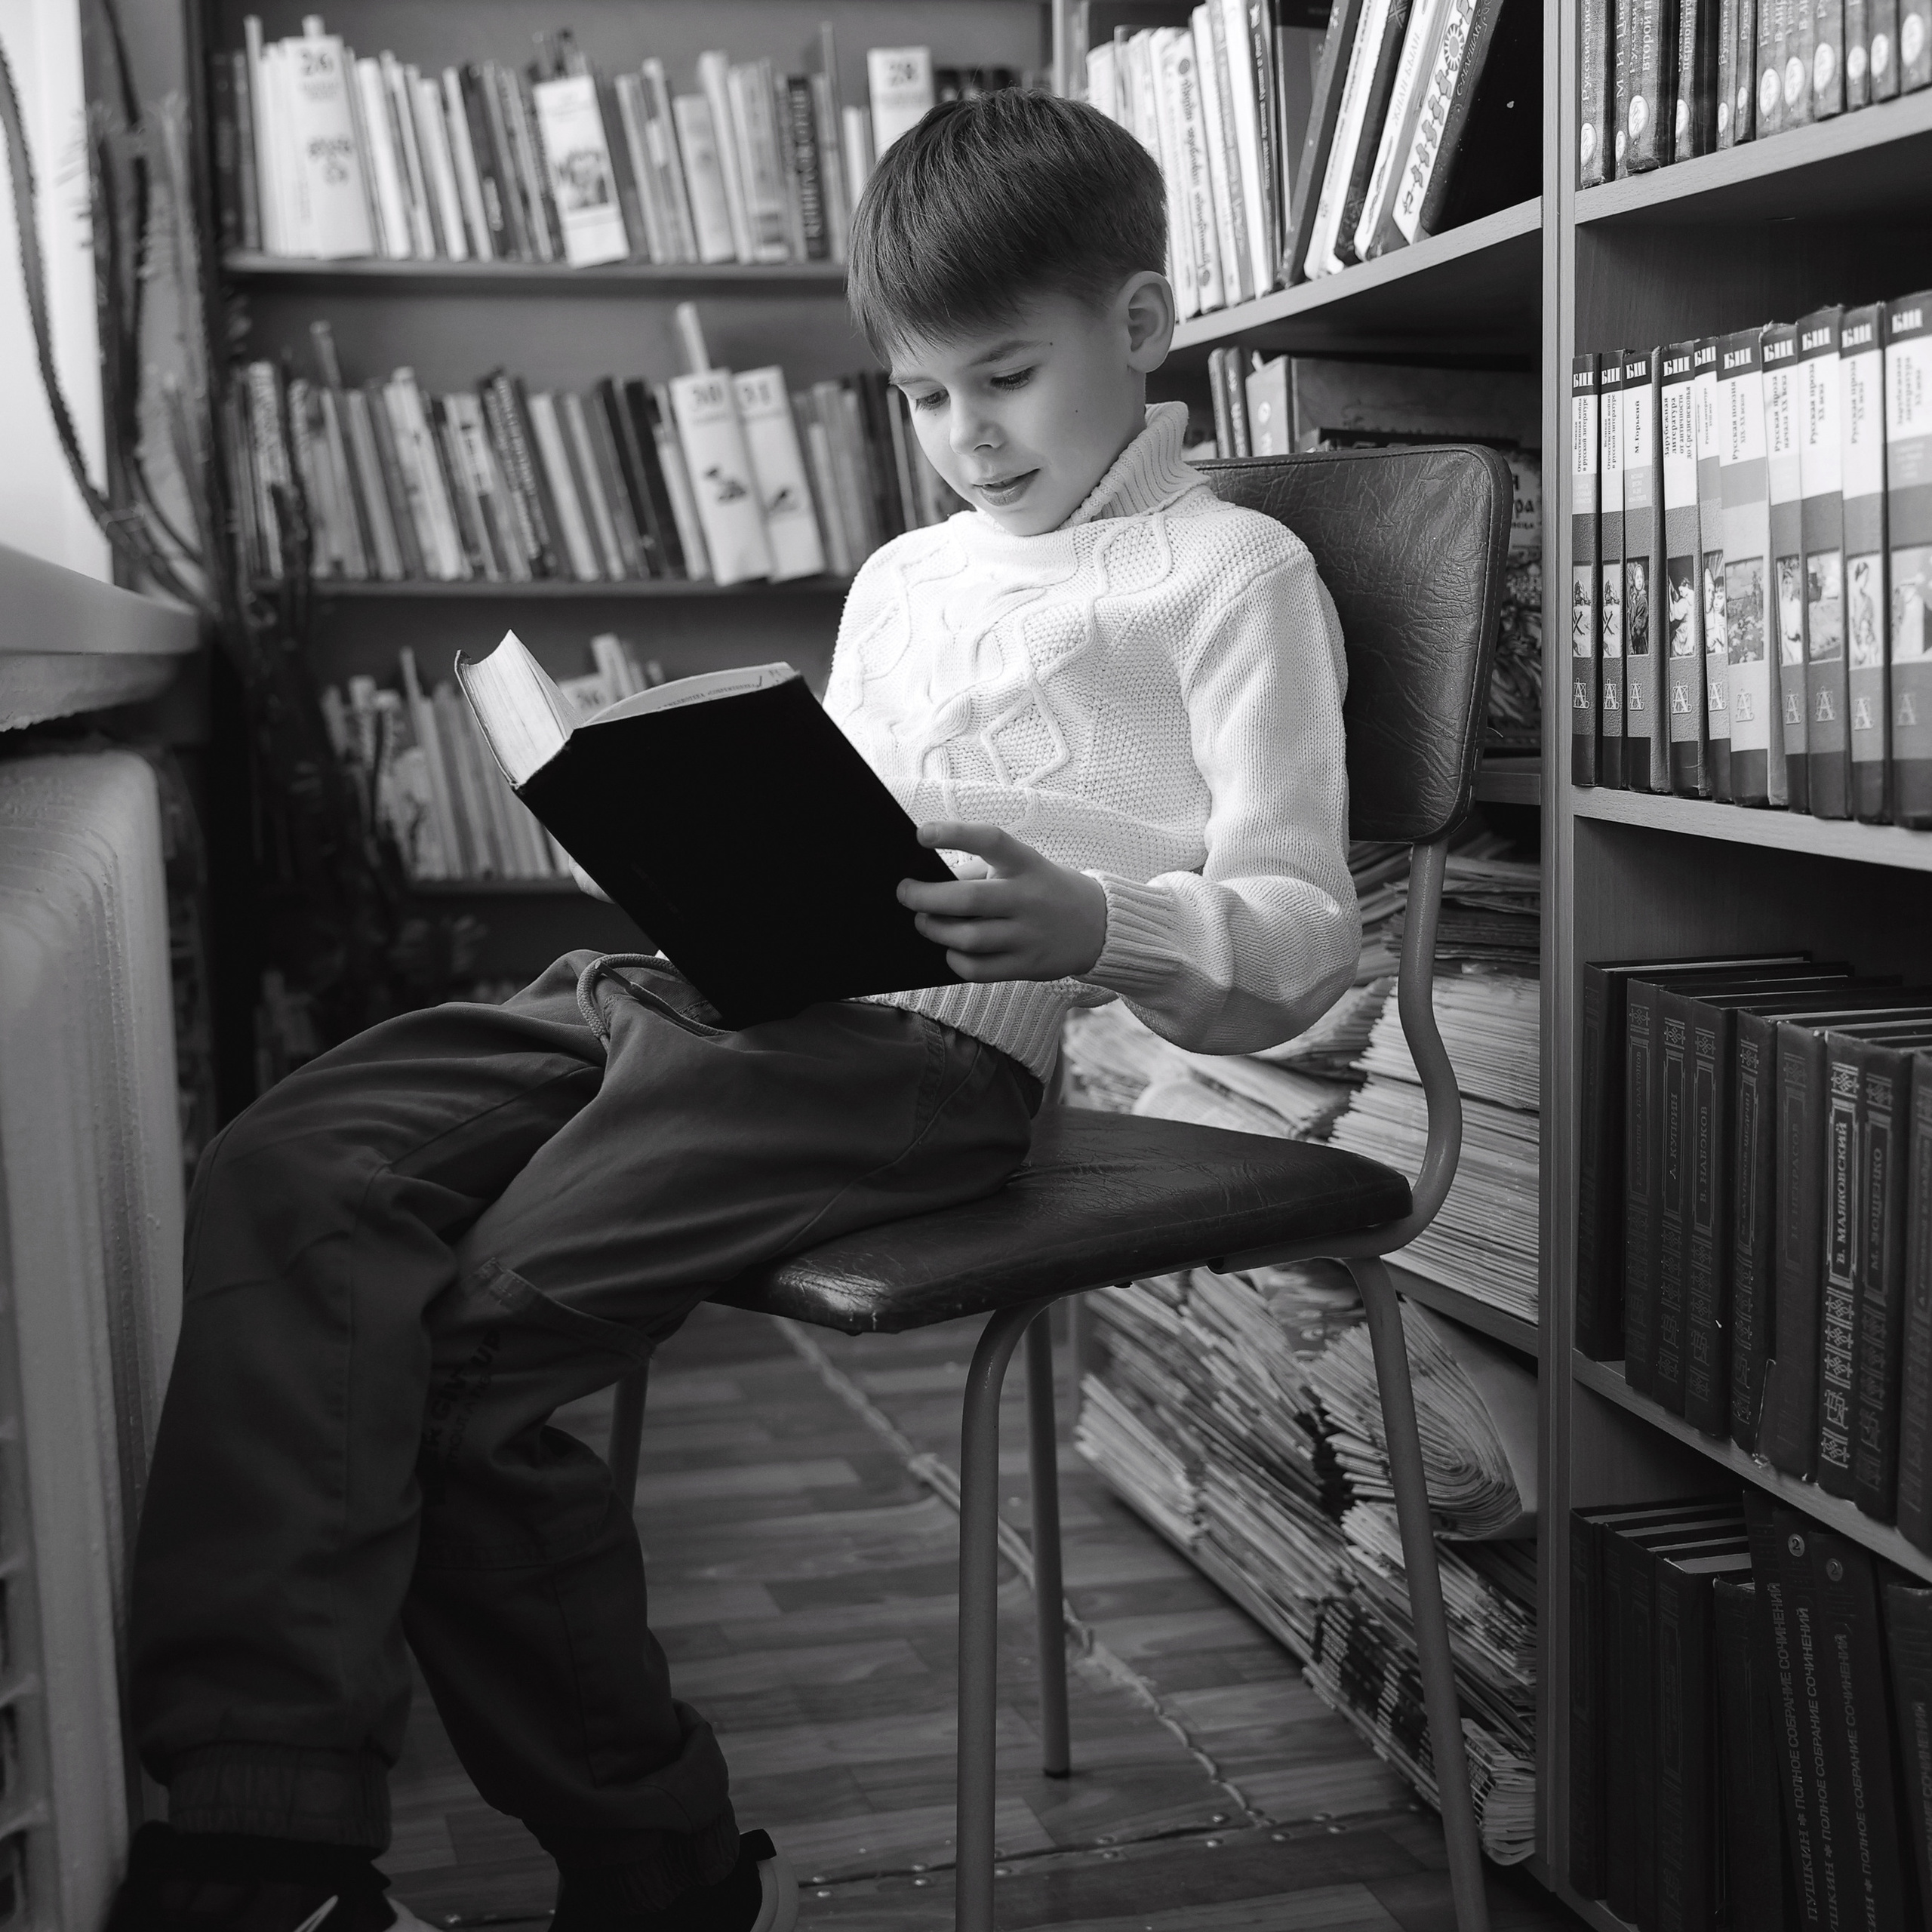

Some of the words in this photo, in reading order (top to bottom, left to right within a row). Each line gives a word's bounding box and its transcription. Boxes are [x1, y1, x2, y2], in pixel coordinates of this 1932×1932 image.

[1640, 15, 1654, 72] второй
[1683, 20, 1693, 71] первой
[1718, 11, 1729, 66] Русская
[1581, 38, 1592, 101] Русские
[1763, 339, 1795, 363] БШ
[1801, 327, 1831, 352] БШ
[1841, 322, 1873, 349] БШ
[1601, 367, 1621, 385] БШ
[1626, 360, 1647, 380] БШ
[1663, 355, 1690, 377] БШ
[1694, 346, 1717, 368] БШ
[1724, 347, 1752, 371] БШ
[1573, 371, 1594, 388] БШ
[1808, 363, 1817, 398] проза
[1809, 400, 1818, 445] Русская
[1850, 399, 1860, 445] Русская
[1635, 443, 1639, 454] М.
[1679, 445, 1684, 454] от
[1687, 449, 1693, 460] до
[1700, 1106, 1708, 1184] НАБОКОВ
[1669, 1164, 1676, 1180] А.
[1835, 1122, 1847, 1244] МАЯКОВСКИЙ
[1700, 1189, 1706, 1203] В.
[1871, 1148, 1883, 1246] ЗОЩЕНКО
[1835, 1249, 1845, 1265] В.
[1870, 1251, 1878, 1270] М.
[1792, 1538, 1801, 1551] 2
[1829, 1562, 1838, 1575] 2
[1767, 1583, 1790, 1669] СОЧИНЕНИЙ
[1796, 1607, 1817, 1697] СОЧИНЕНИЙ
[1834, 1633, 1856, 1727] СОЧИНЕНИЙ
[1780, 1672, 1799, 1748] СОБРАНИЕ
[1808, 1700, 1826, 1777] СОБРАНИЕ
[1789, 1749, 1806, 1810] ПОЛНОЕ
[1847, 1730, 1865, 1809] СОБРАНИЕ
[1816, 1779, 1832, 1841] ПОЛНОЕ
[1856, 1811, 1872, 1875] ПОЛНОЕ
[1798, 1829, 1818, 1922] ПУШКИН
